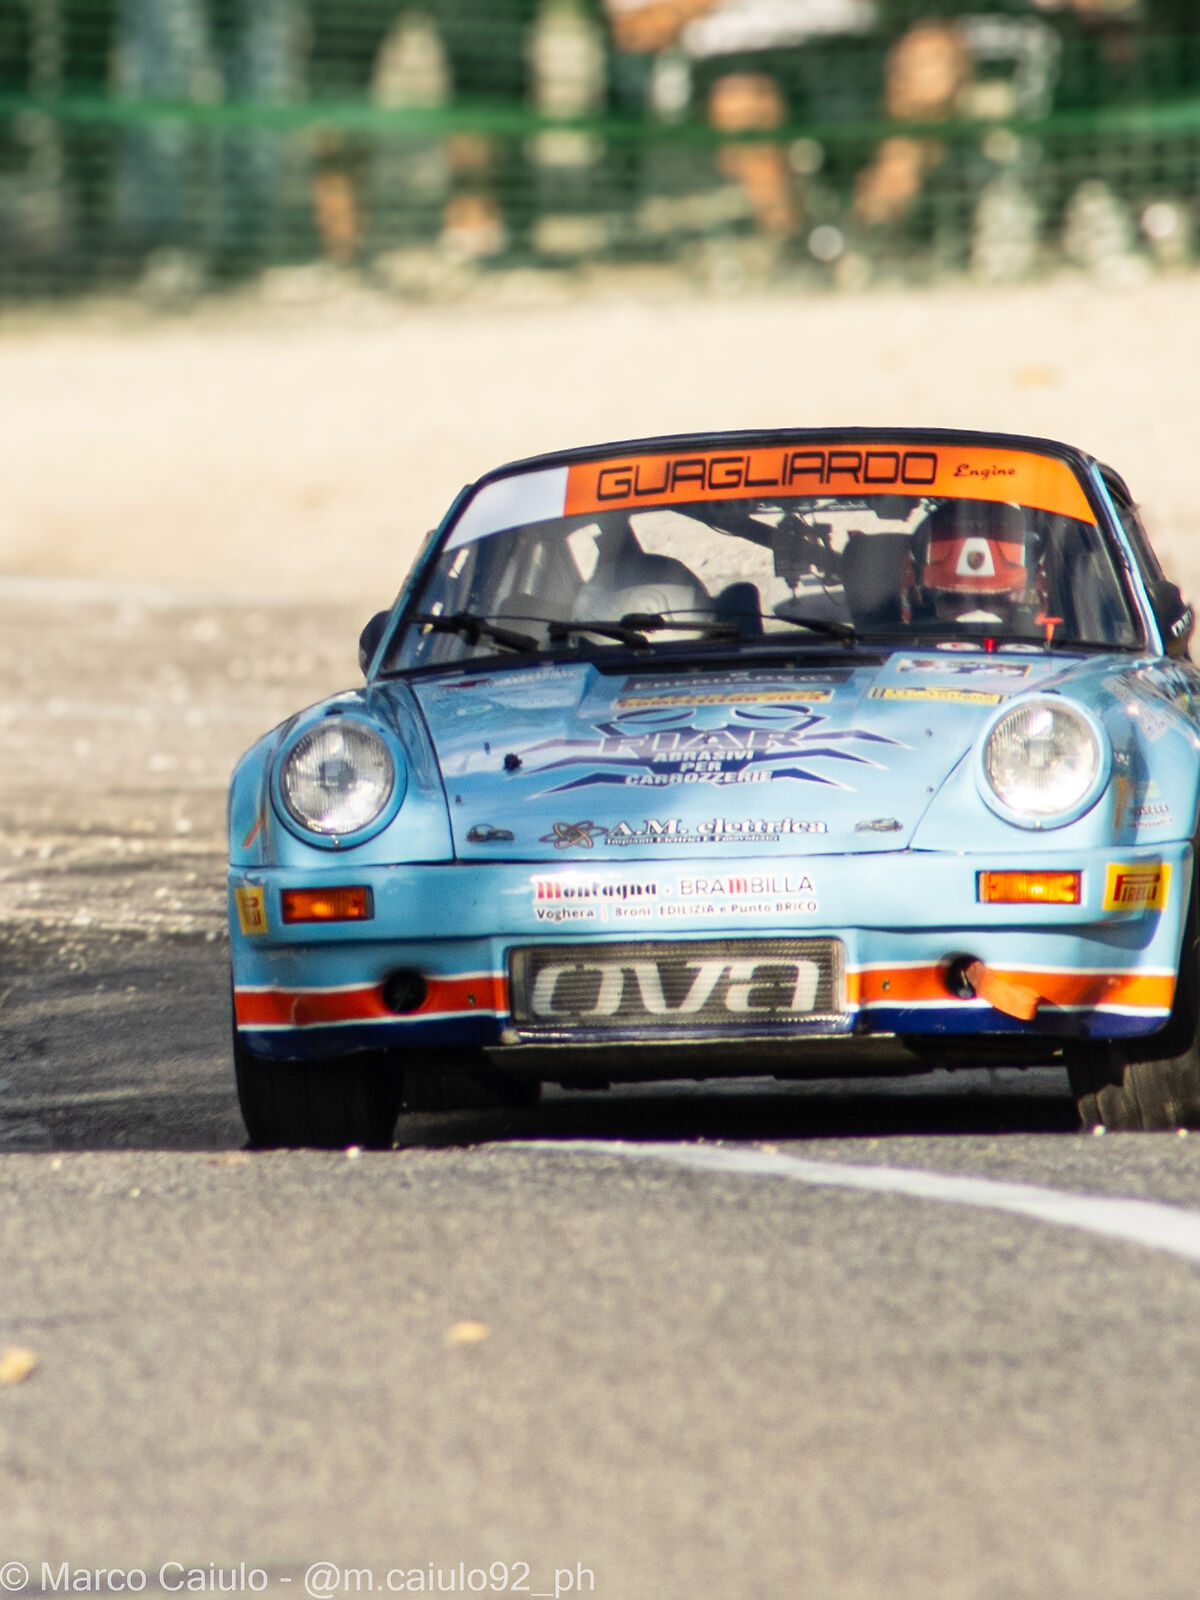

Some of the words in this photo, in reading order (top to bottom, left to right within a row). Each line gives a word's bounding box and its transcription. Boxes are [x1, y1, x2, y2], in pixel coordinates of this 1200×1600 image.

[597, 451, 938, 501] GUAGLIARDO
[953, 463, 1016, 481] Engine
[652, 750, 755, 763] ABRASIVI
[679, 761, 722, 773] PER
[609, 819, 689, 837] A.M.
[697, 817, 829, 835] elettrica
[537, 881, 657, 900] Montagna
[1113, 873, 1161, 902] PIRELLI
[536, 908, 595, 922] Voghera
[615, 907, 651, 917] Broni
[660, 904, 715, 915] EDILIZIA
[731, 903, 772, 913] Punto
[775, 901, 817, 912] BRICO
